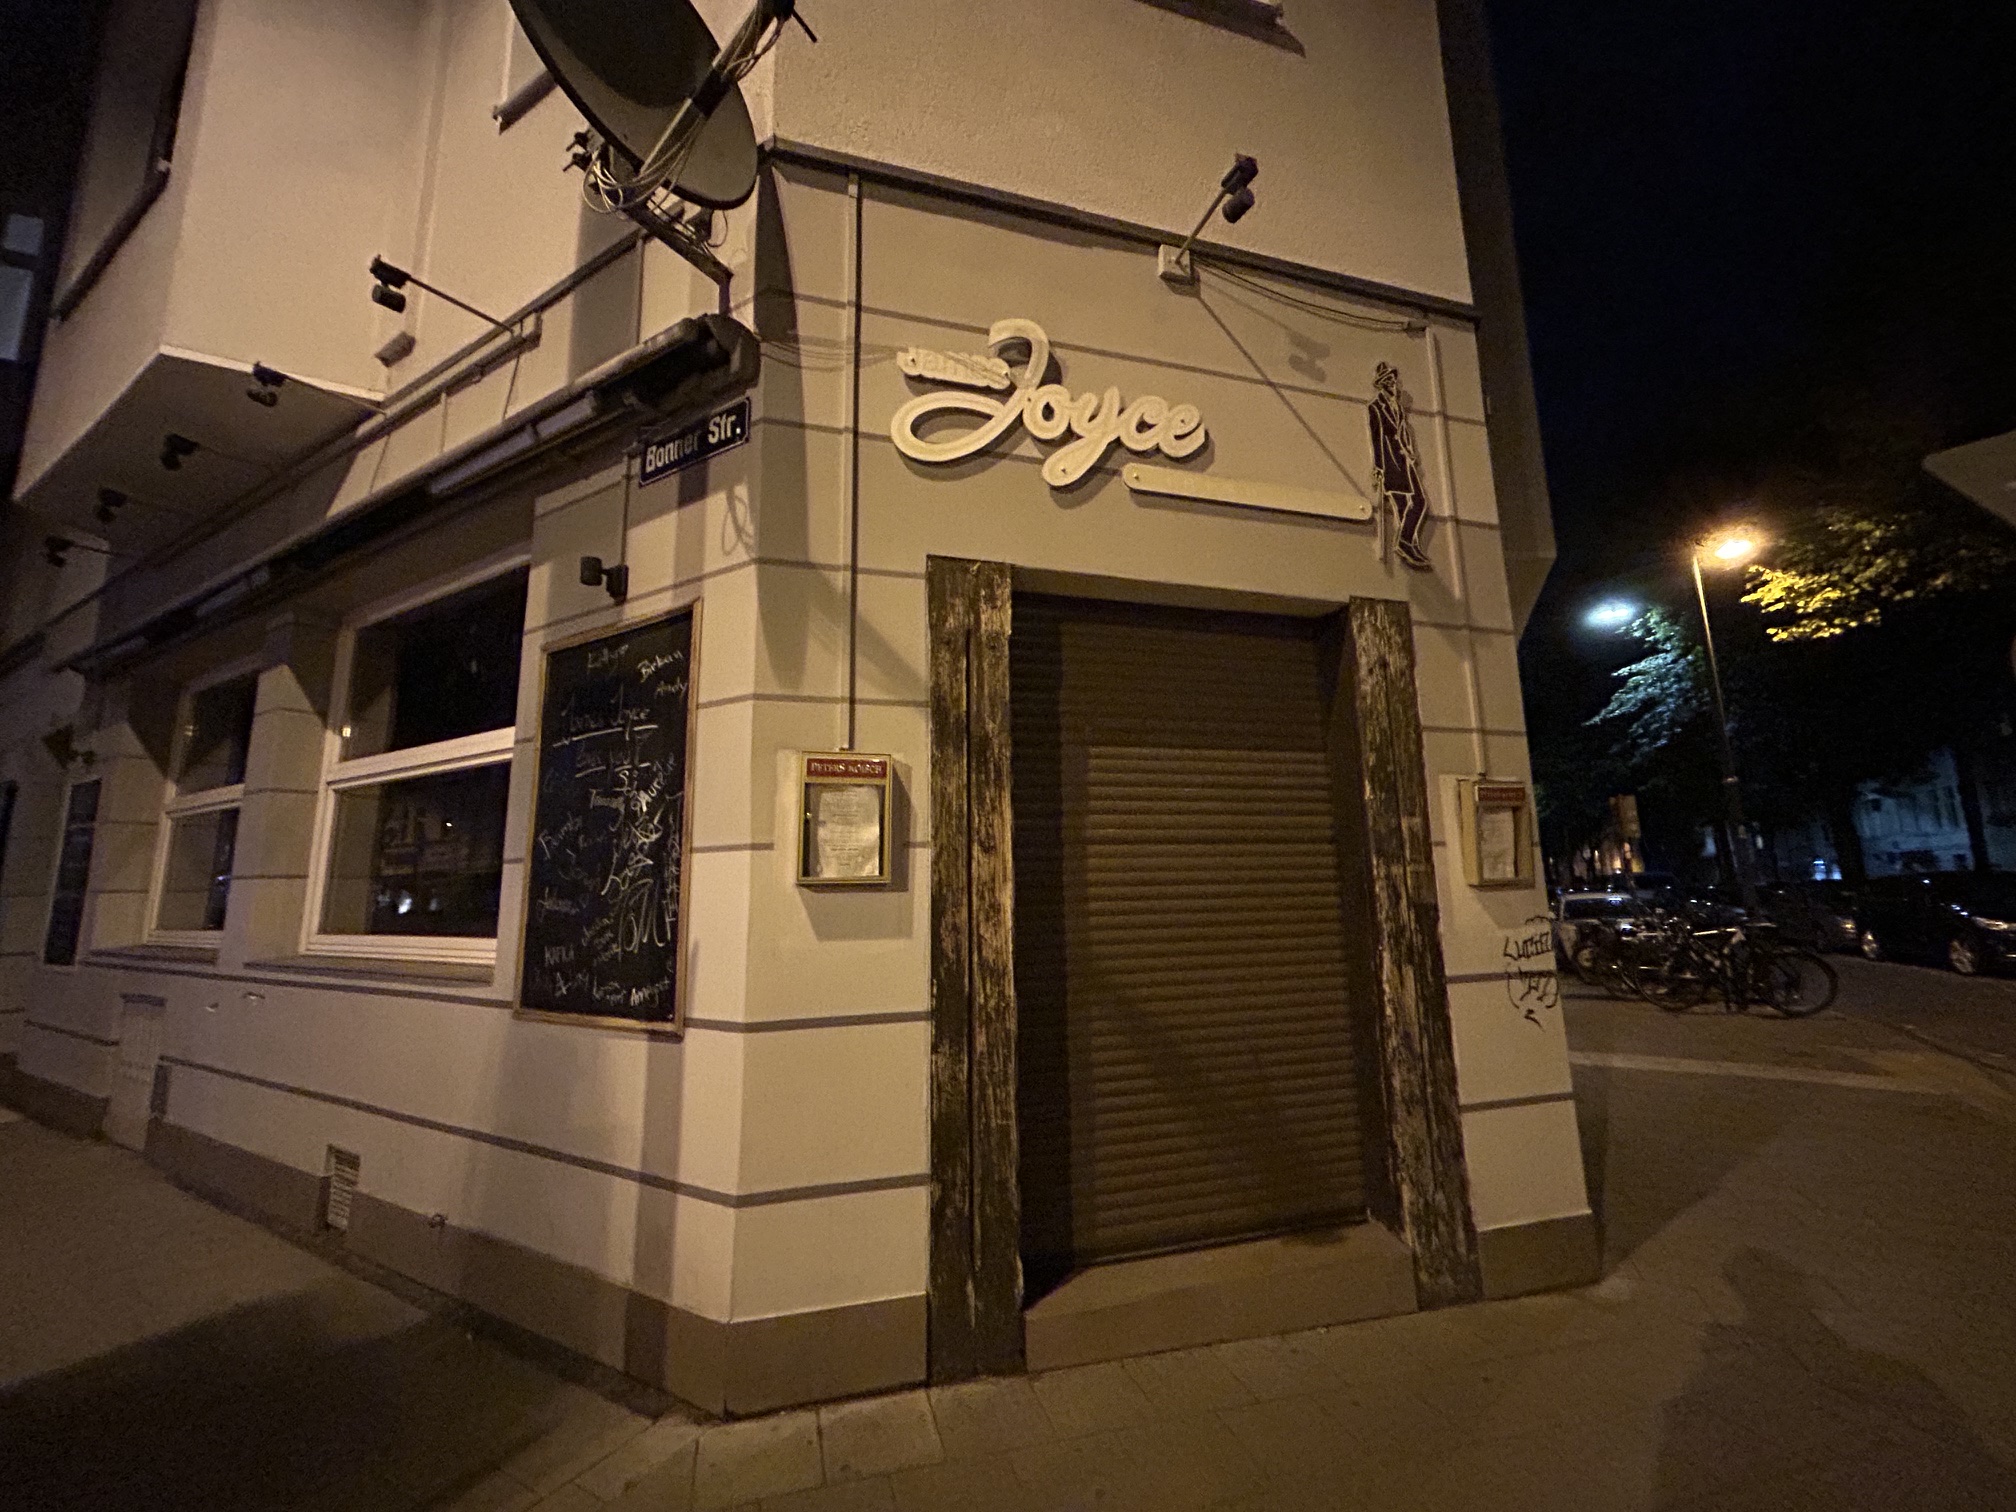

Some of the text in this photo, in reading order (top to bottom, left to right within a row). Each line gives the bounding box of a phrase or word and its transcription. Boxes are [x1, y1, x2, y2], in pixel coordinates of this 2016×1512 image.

[645, 413, 741, 473] Bonner Str.
[890, 317, 1206, 487] Joyce
